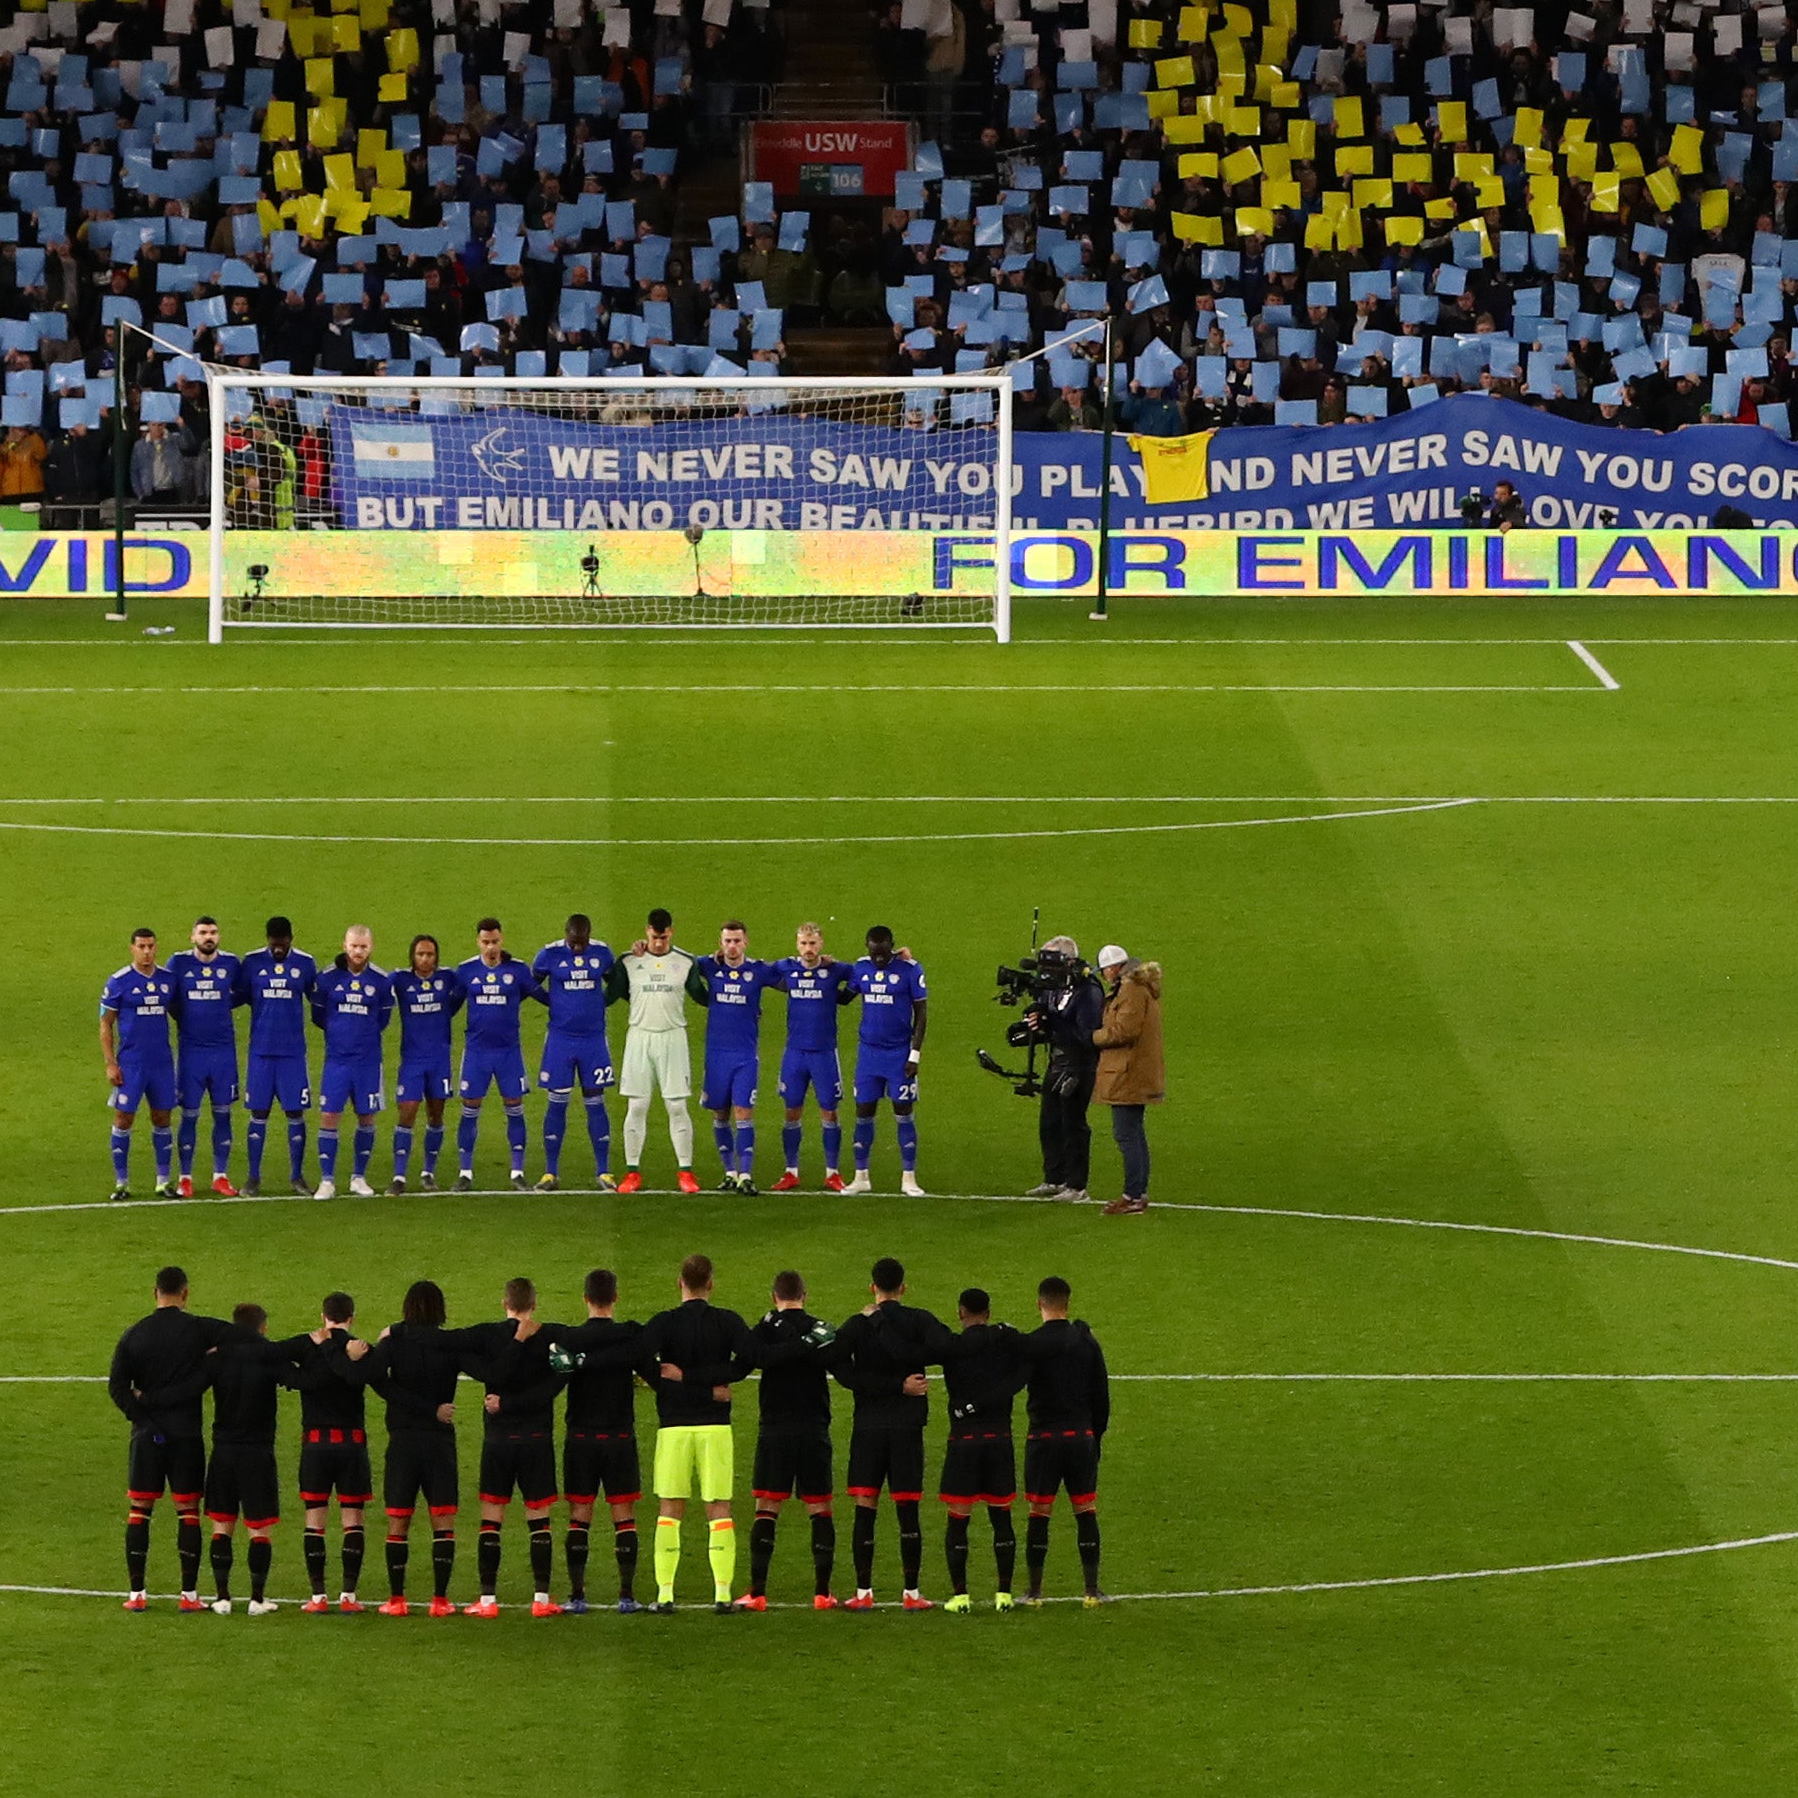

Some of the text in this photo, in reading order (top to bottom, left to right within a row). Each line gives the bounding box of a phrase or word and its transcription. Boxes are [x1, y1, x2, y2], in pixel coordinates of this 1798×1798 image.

[804, 132, 858, 152] USW
[548, 445, 620, 480] WE
[636, 443, 795, 482] NEVER
[809, 447, 912, 491] SAW
[1291, 433, 1449, 487] NEVER
[1460, 429, 1563, 477] SAW
[1575, 449, 1674, 493] YOU
[355, 497, 443, 529] BUT
[457, 496, 674, 530] EMILIANO
[688, 499, 785, 530] OUR
[1306, 497, 1375, 530] WE
[934, 536, 1185, 590] FOR
[593, 1066, 615, 1085] 22
